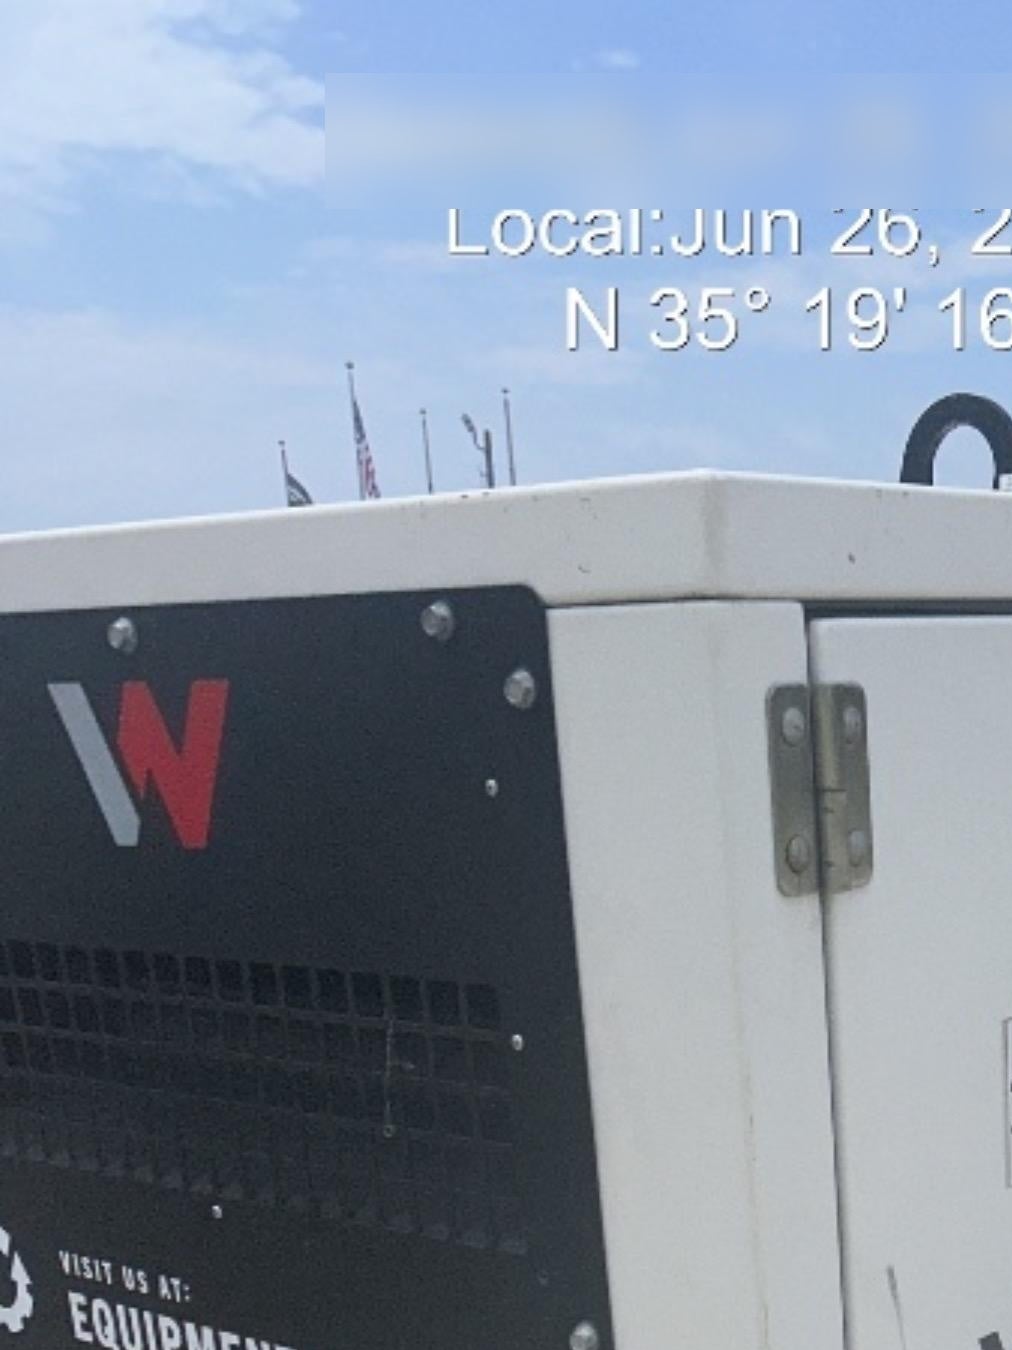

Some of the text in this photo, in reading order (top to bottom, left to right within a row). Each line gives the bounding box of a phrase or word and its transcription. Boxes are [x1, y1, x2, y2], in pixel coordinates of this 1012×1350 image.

[58, 1250, 191, 1304] VISIT US AT:
